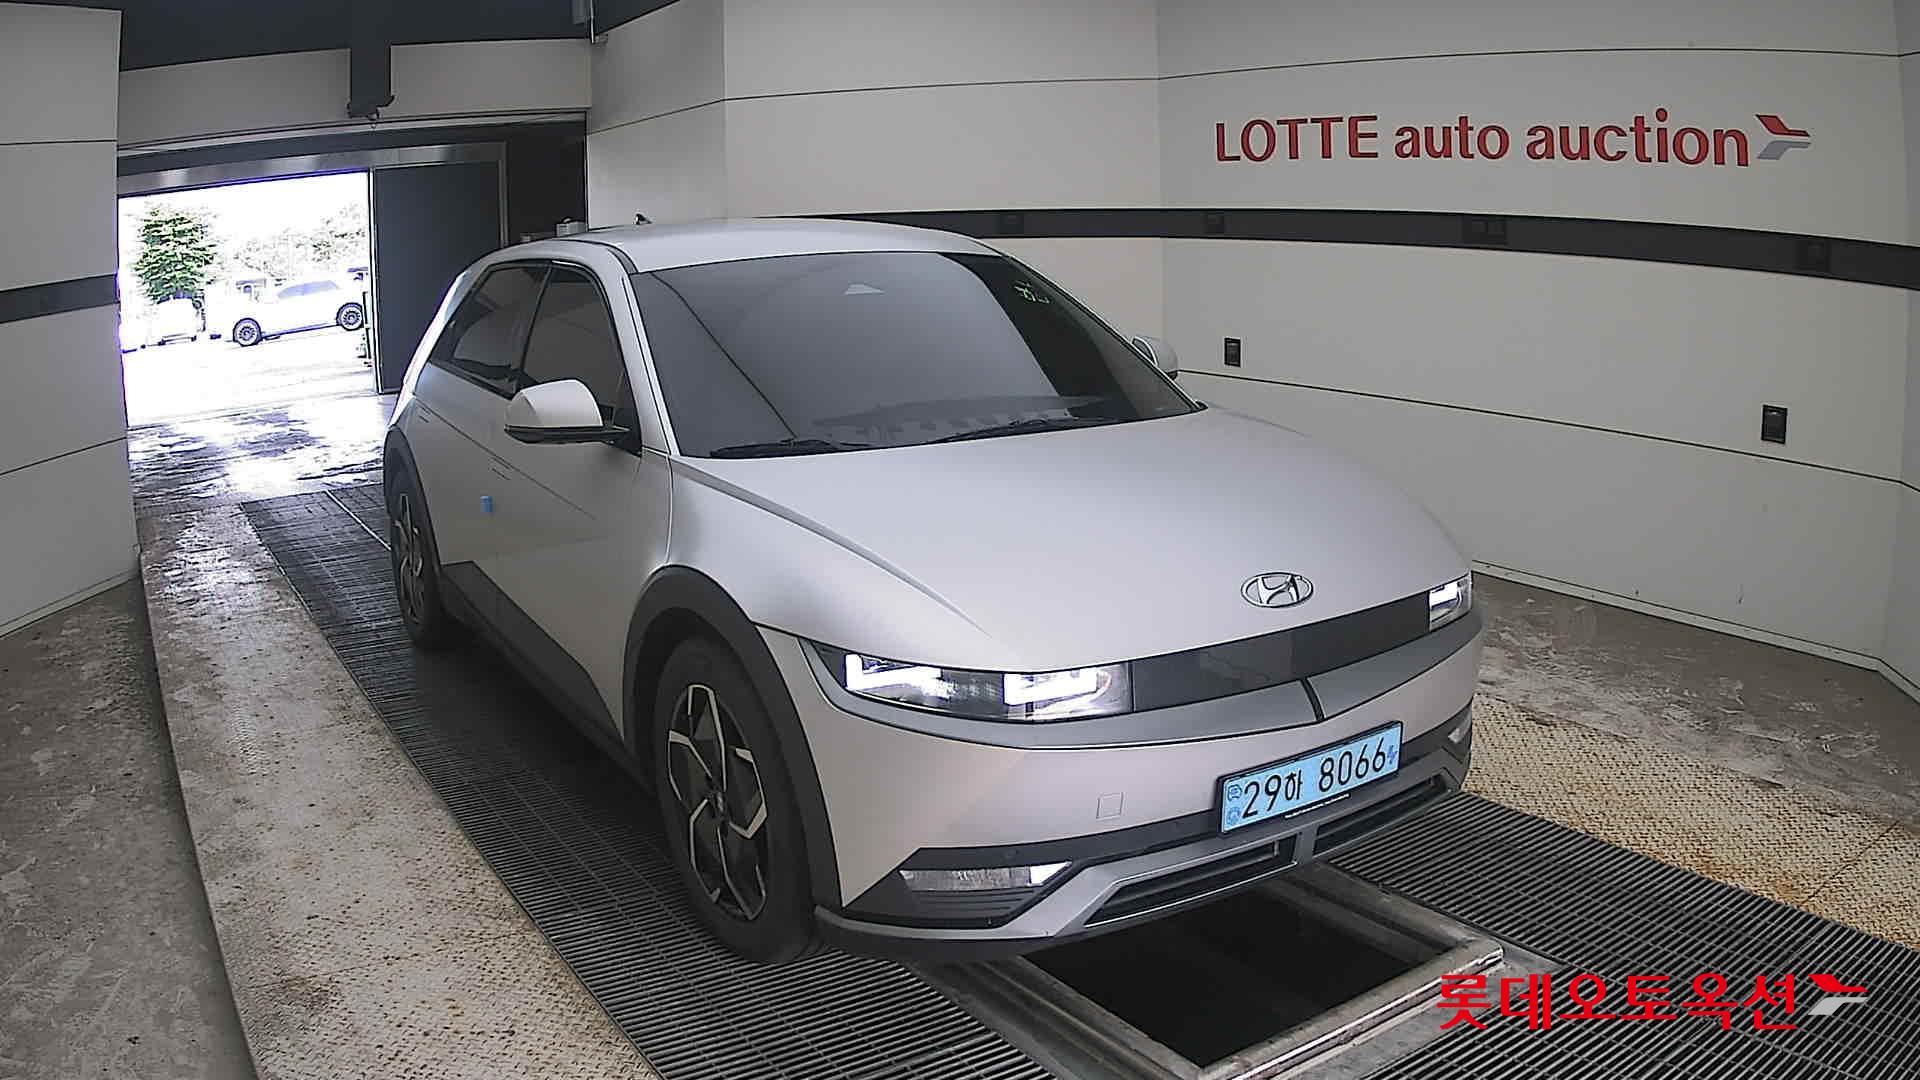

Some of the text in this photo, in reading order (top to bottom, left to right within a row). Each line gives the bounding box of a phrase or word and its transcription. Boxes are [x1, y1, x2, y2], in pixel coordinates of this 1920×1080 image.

[1216, 107, 1750, 167] LOTTE auto auction
[1241, 737, 1386, 819] 29하 8066
